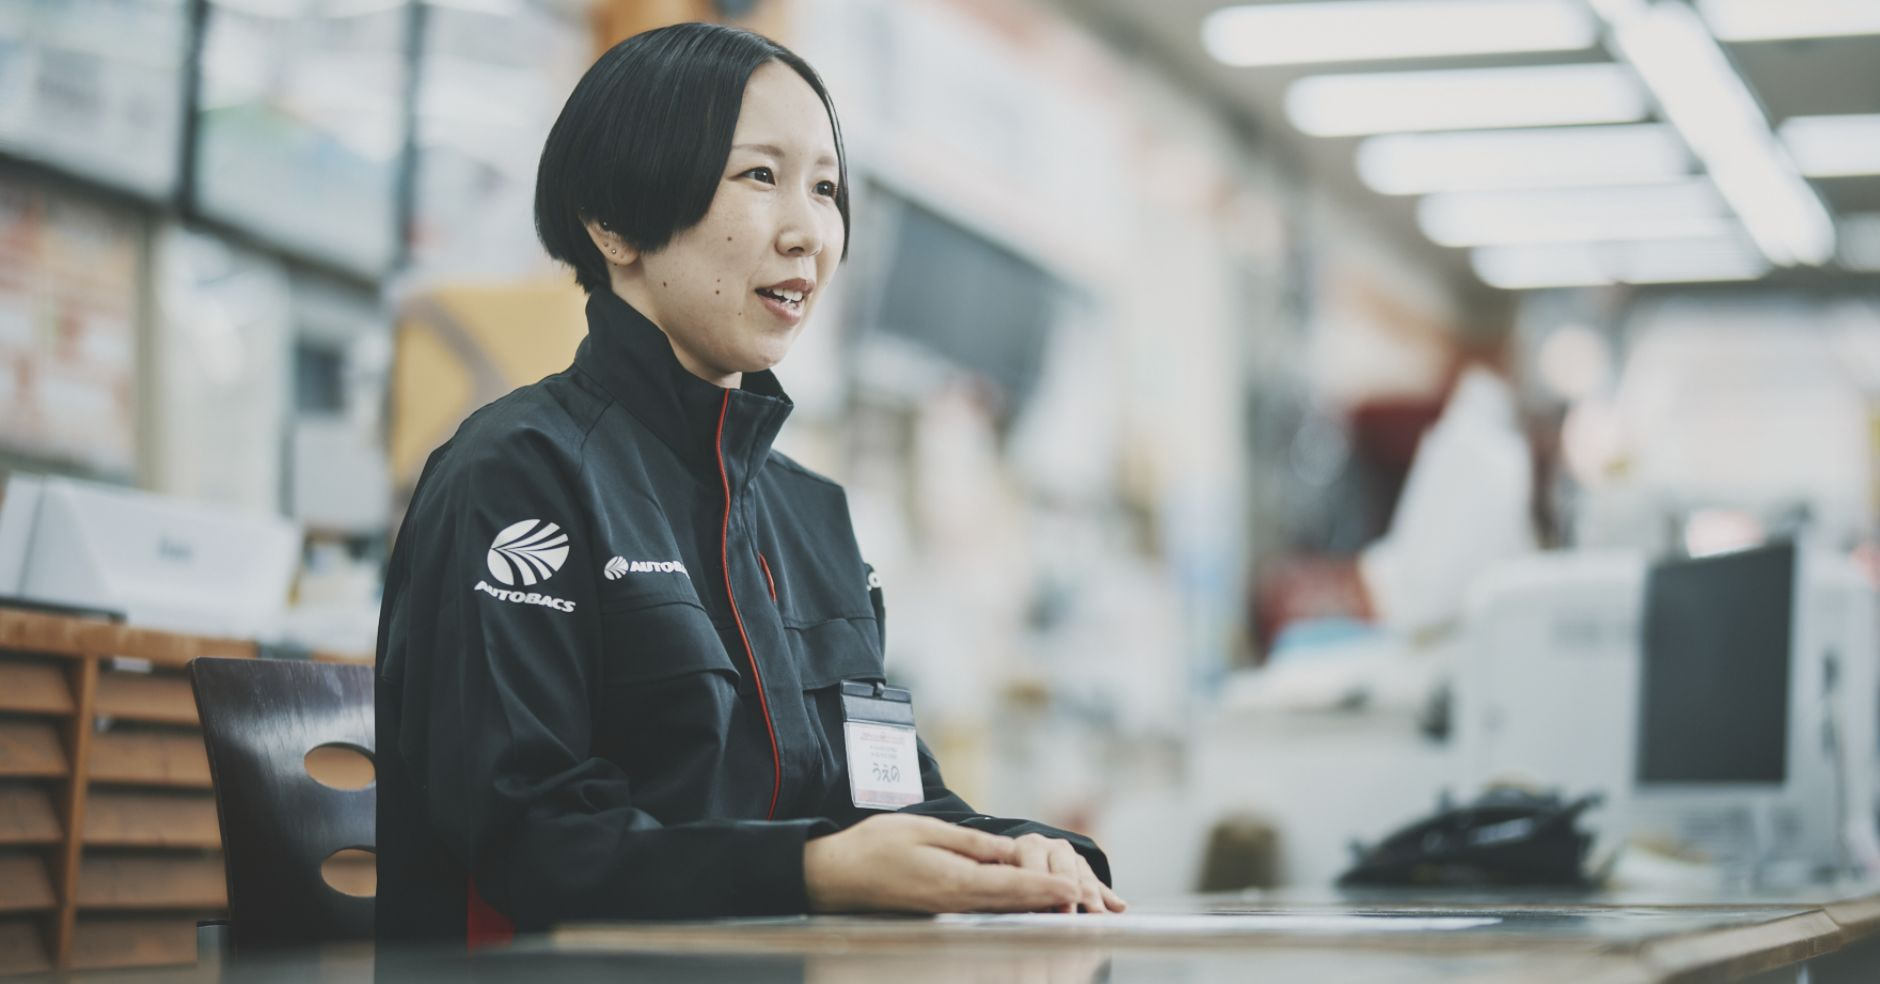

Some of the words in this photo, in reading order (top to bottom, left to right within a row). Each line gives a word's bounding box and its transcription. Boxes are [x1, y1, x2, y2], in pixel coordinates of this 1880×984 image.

[474, 580, 576, 613] AUTOBACS
[872, 762, 901, 783] うえの
